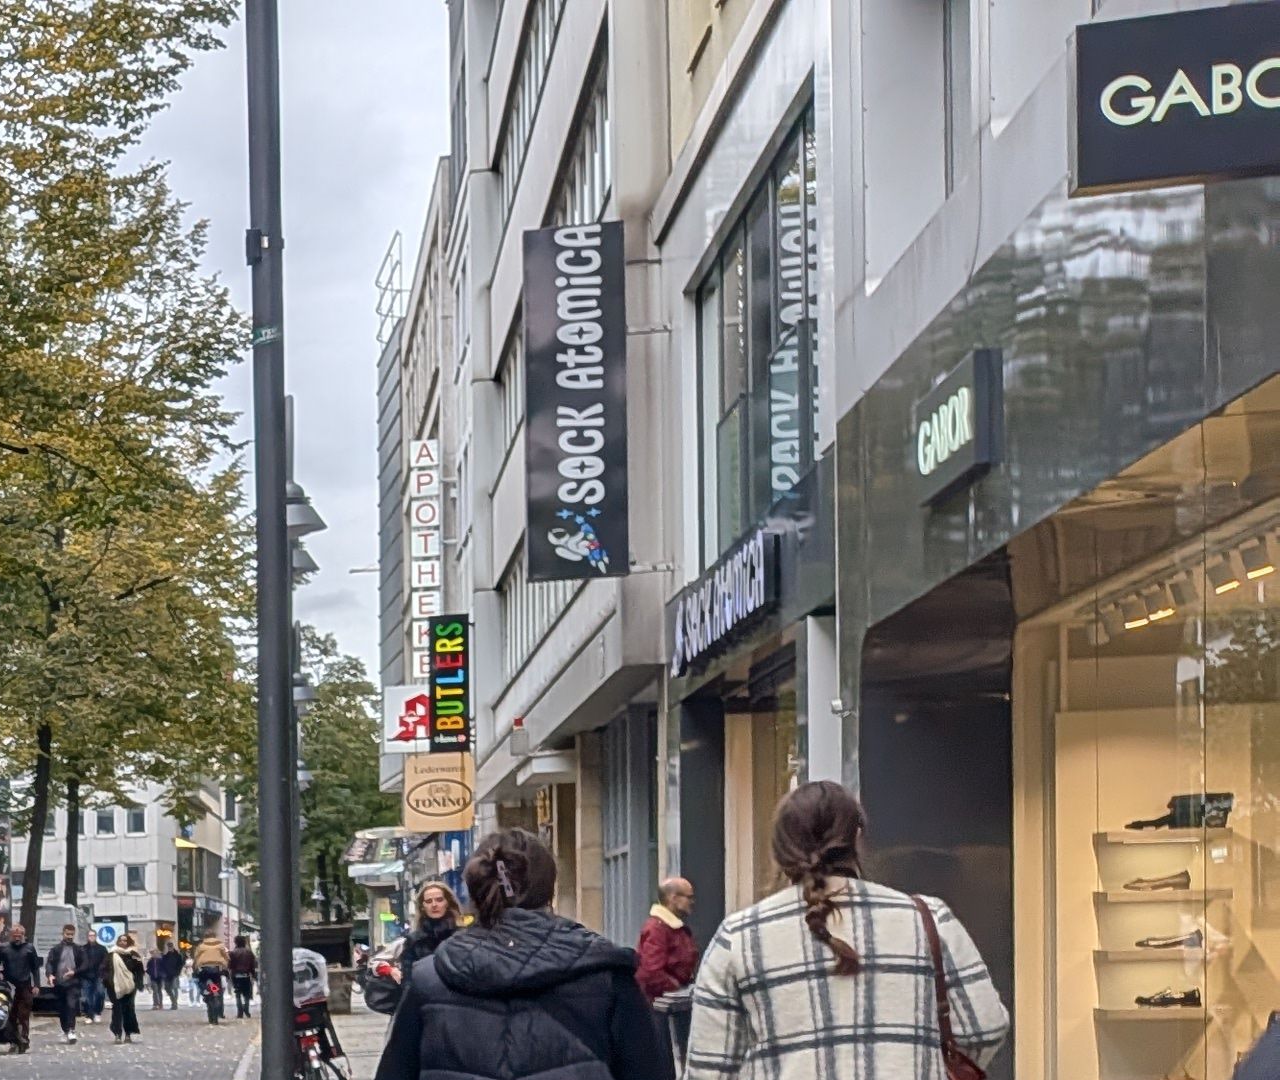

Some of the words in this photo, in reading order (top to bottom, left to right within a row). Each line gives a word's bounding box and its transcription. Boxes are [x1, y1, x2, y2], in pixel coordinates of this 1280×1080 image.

[557, 403, 606, 504] SOCK
[918, 387, 972, 475] GABOR
[415, 443, 437, 676] APOTHEKE
[435, 622, 465, 731] BUTLERS
[414, 796, 468, 809] TONINO
